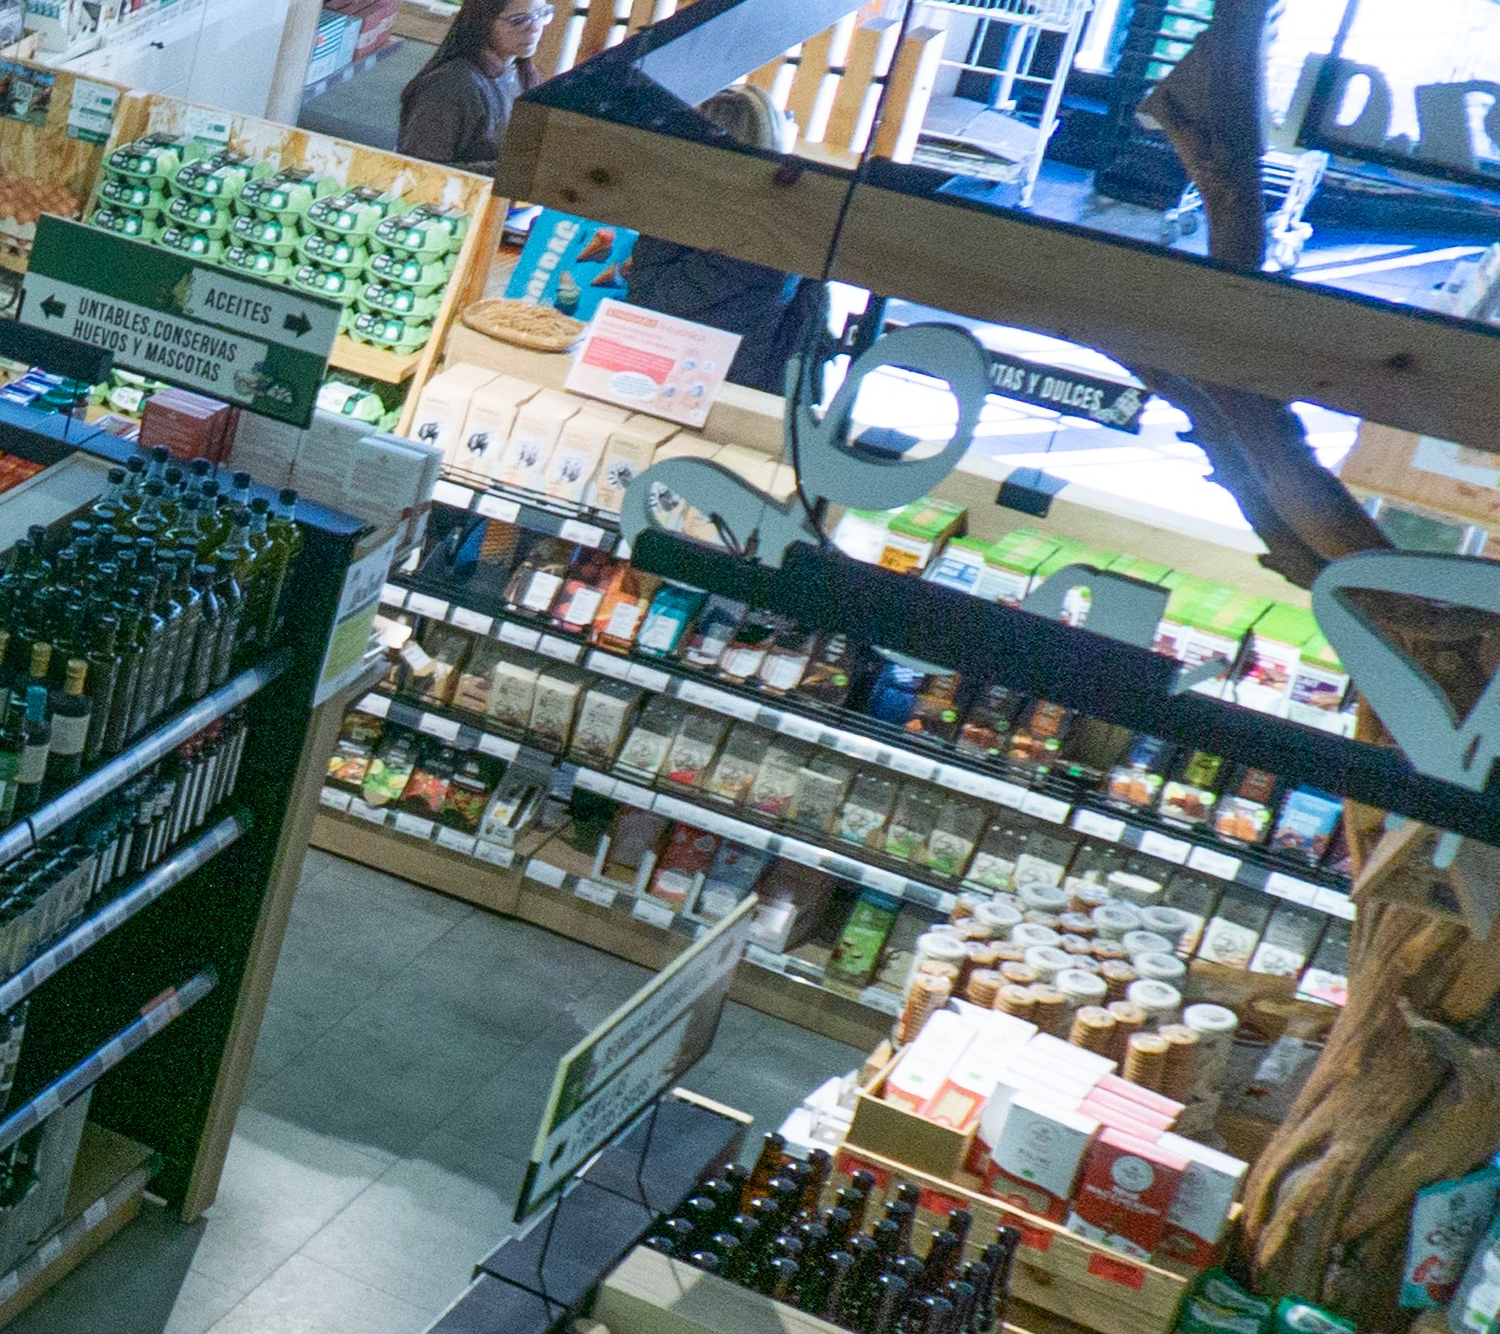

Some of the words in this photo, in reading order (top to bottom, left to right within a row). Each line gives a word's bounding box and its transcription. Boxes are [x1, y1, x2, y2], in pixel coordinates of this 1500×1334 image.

[204, 288, 272, 325] ACEITES
[73, 318, 127, 353] HUEVOS
[133, 338, 141, 356] Y
[145, 342, 222, 383] MASCOTAS
[1029, 376, 1038, 392] Y
[1040, 375, 1104, 412] DULCES
